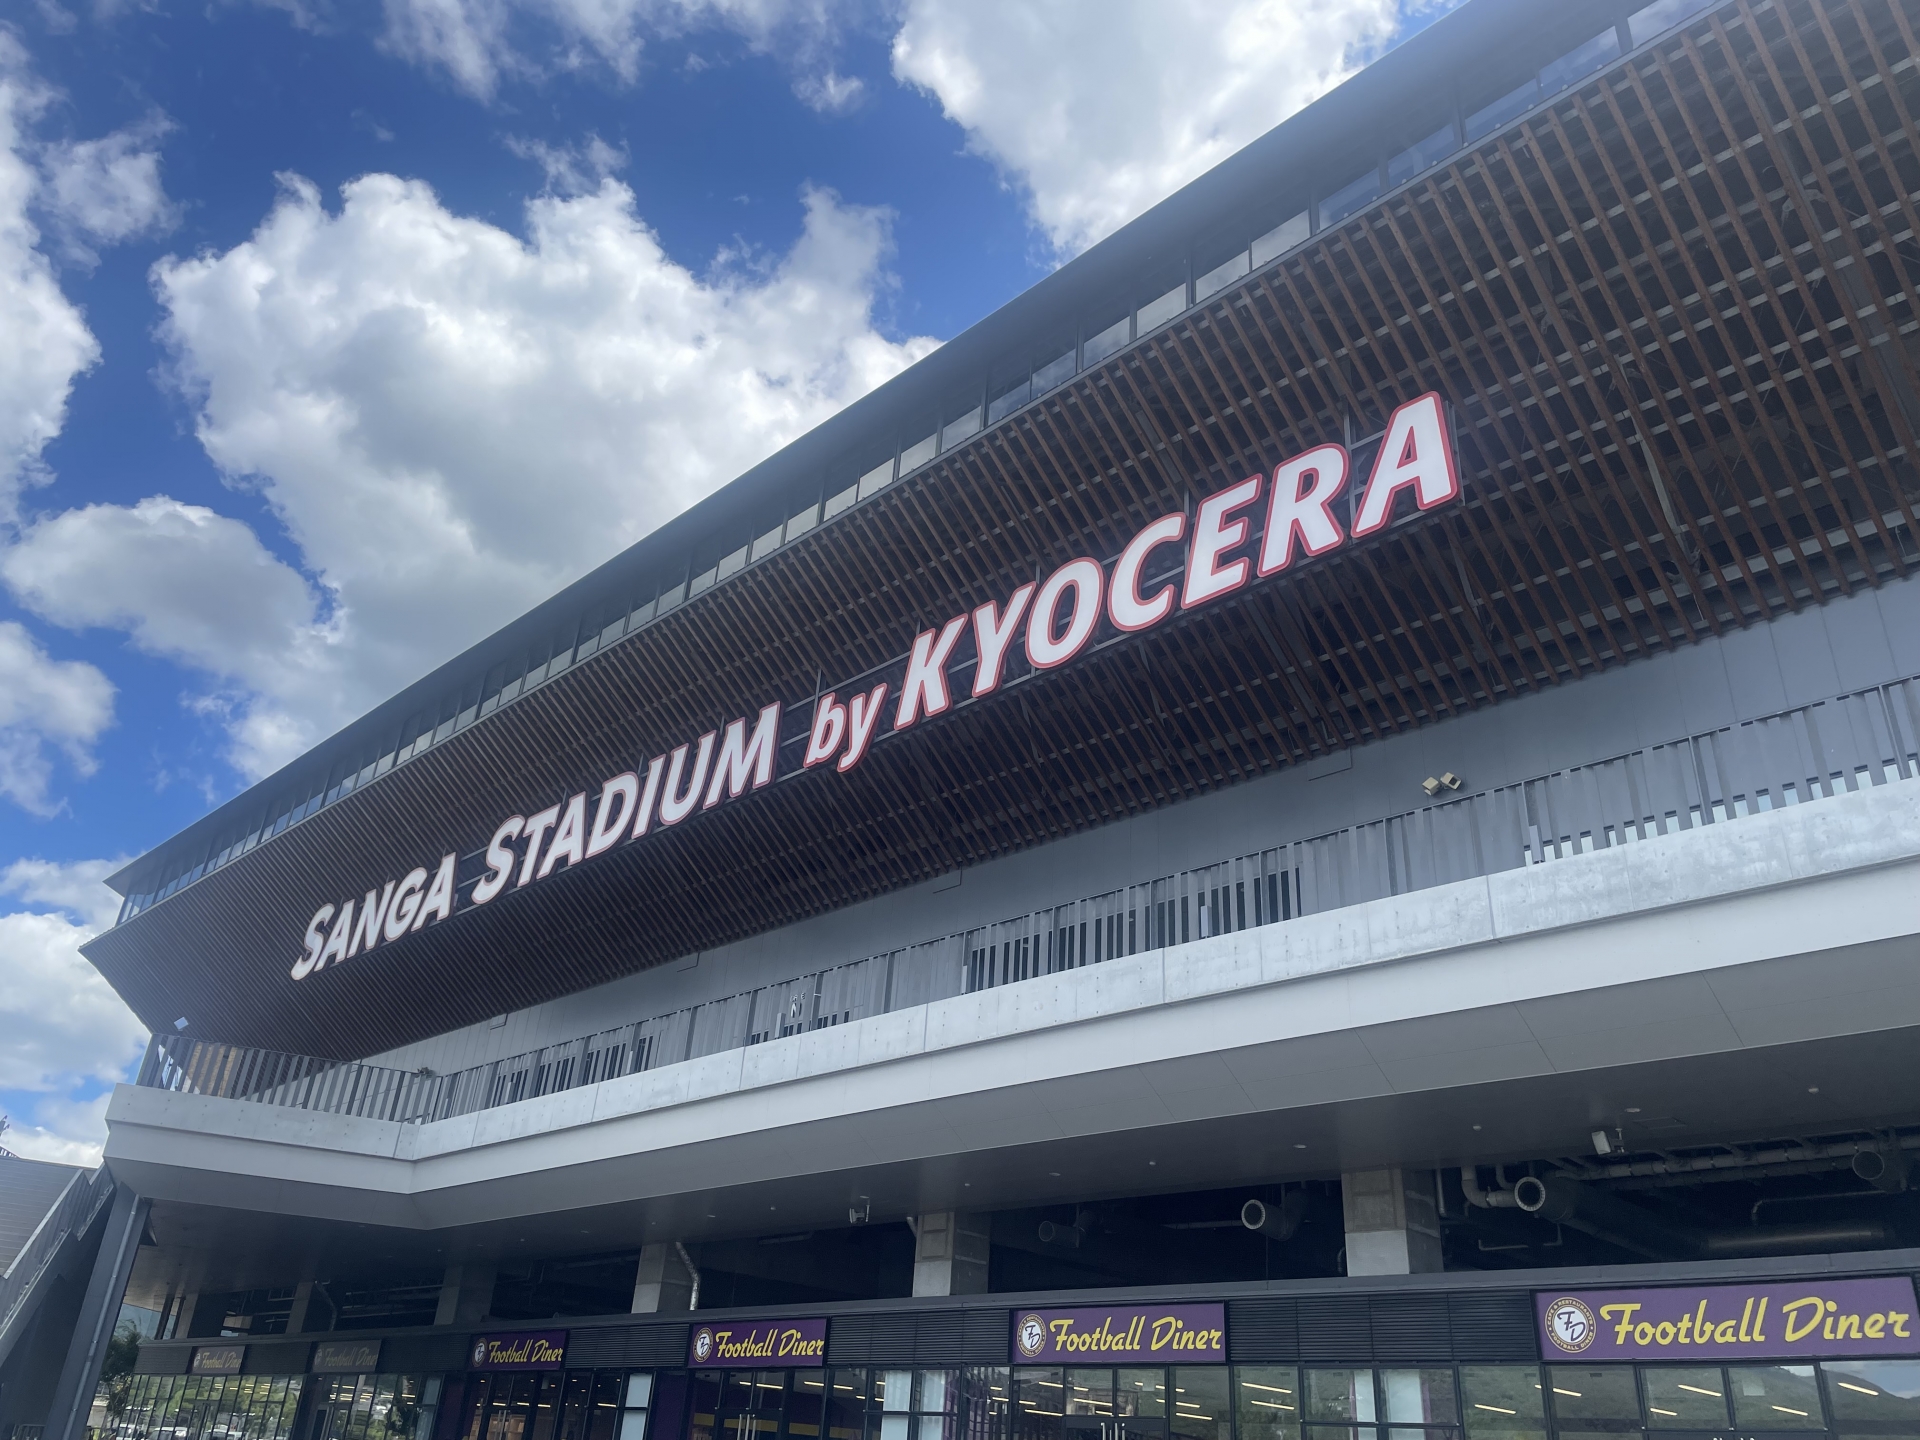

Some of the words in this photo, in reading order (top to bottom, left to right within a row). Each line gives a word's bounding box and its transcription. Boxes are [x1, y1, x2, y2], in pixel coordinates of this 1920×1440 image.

[290, 852, 457, 981] SANGA
[471, 701, 781, 905] STADIUM
[803, 683, 887, 772] by
[894, 391, 1459, 731] KYOCERA
[1050, 1315, 1146, 1351] Football
[1151, 1316, 1222, 1351] Diner
[1599, 1297, 1769, 1345] Football
[1782, 1296, 1911, 1343] Diner
[488, 1339, 533, 1364] Football
[531, 1339, 564, 1363] Diner
[715, 1329, 778, 1358] Football
[778, 1329, 825, 1357] Diner
[1551, 1332, 1579, 1350] FOOTBALL
[1580, 1331, 1594, 1348] DINER
[201, 1350, 228, 1369] Football
[324, 1346, 358, 1366] Football
